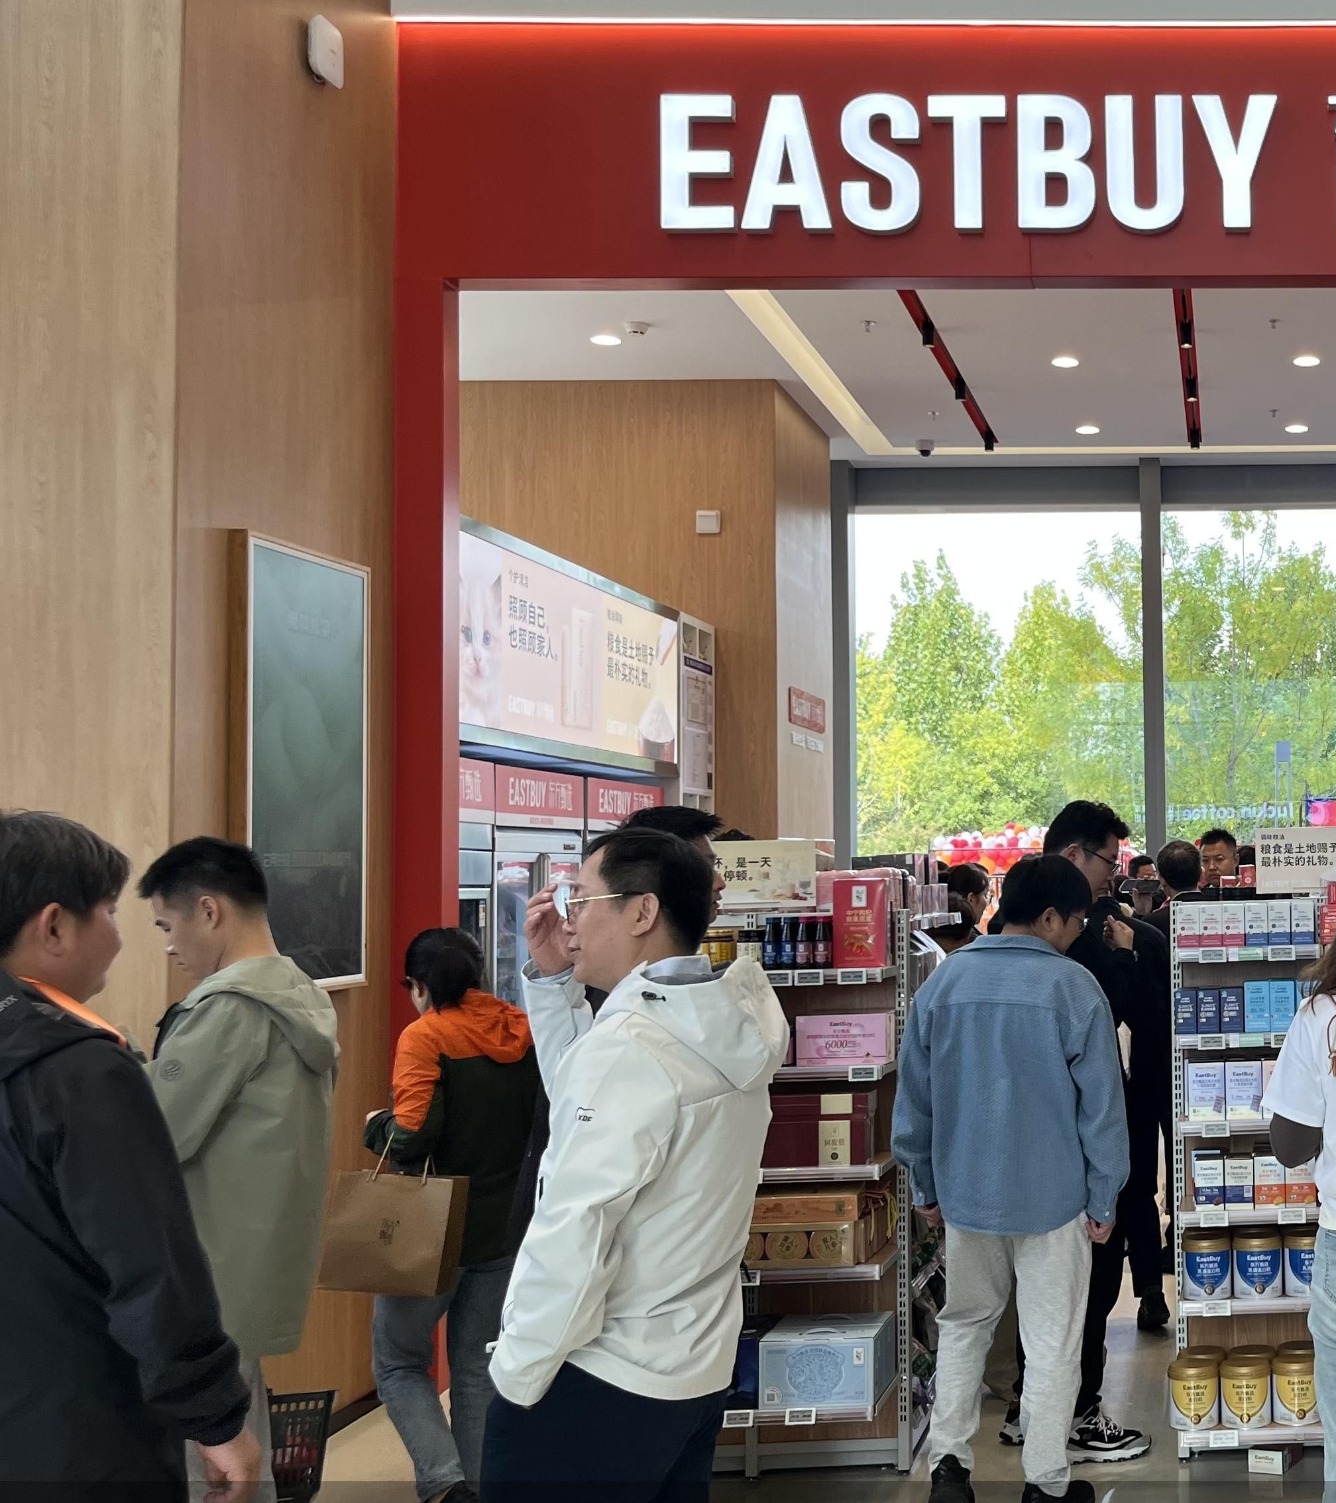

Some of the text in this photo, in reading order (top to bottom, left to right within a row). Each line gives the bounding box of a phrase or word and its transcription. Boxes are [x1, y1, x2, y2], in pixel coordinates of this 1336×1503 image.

[660, 93, 1277, 231] EASTBUY
[459, 769, 482, 802] 方甄选
[509, 777, 546, 808] EASTBUY
[599, 788, 632, 815] EASTBUY
[1260, 855, 1335, 867] 最朴实的礼物。
[825, 1040, 848, 1049] 6000
[1254, 1454, 1275, 1462] EastBuy
